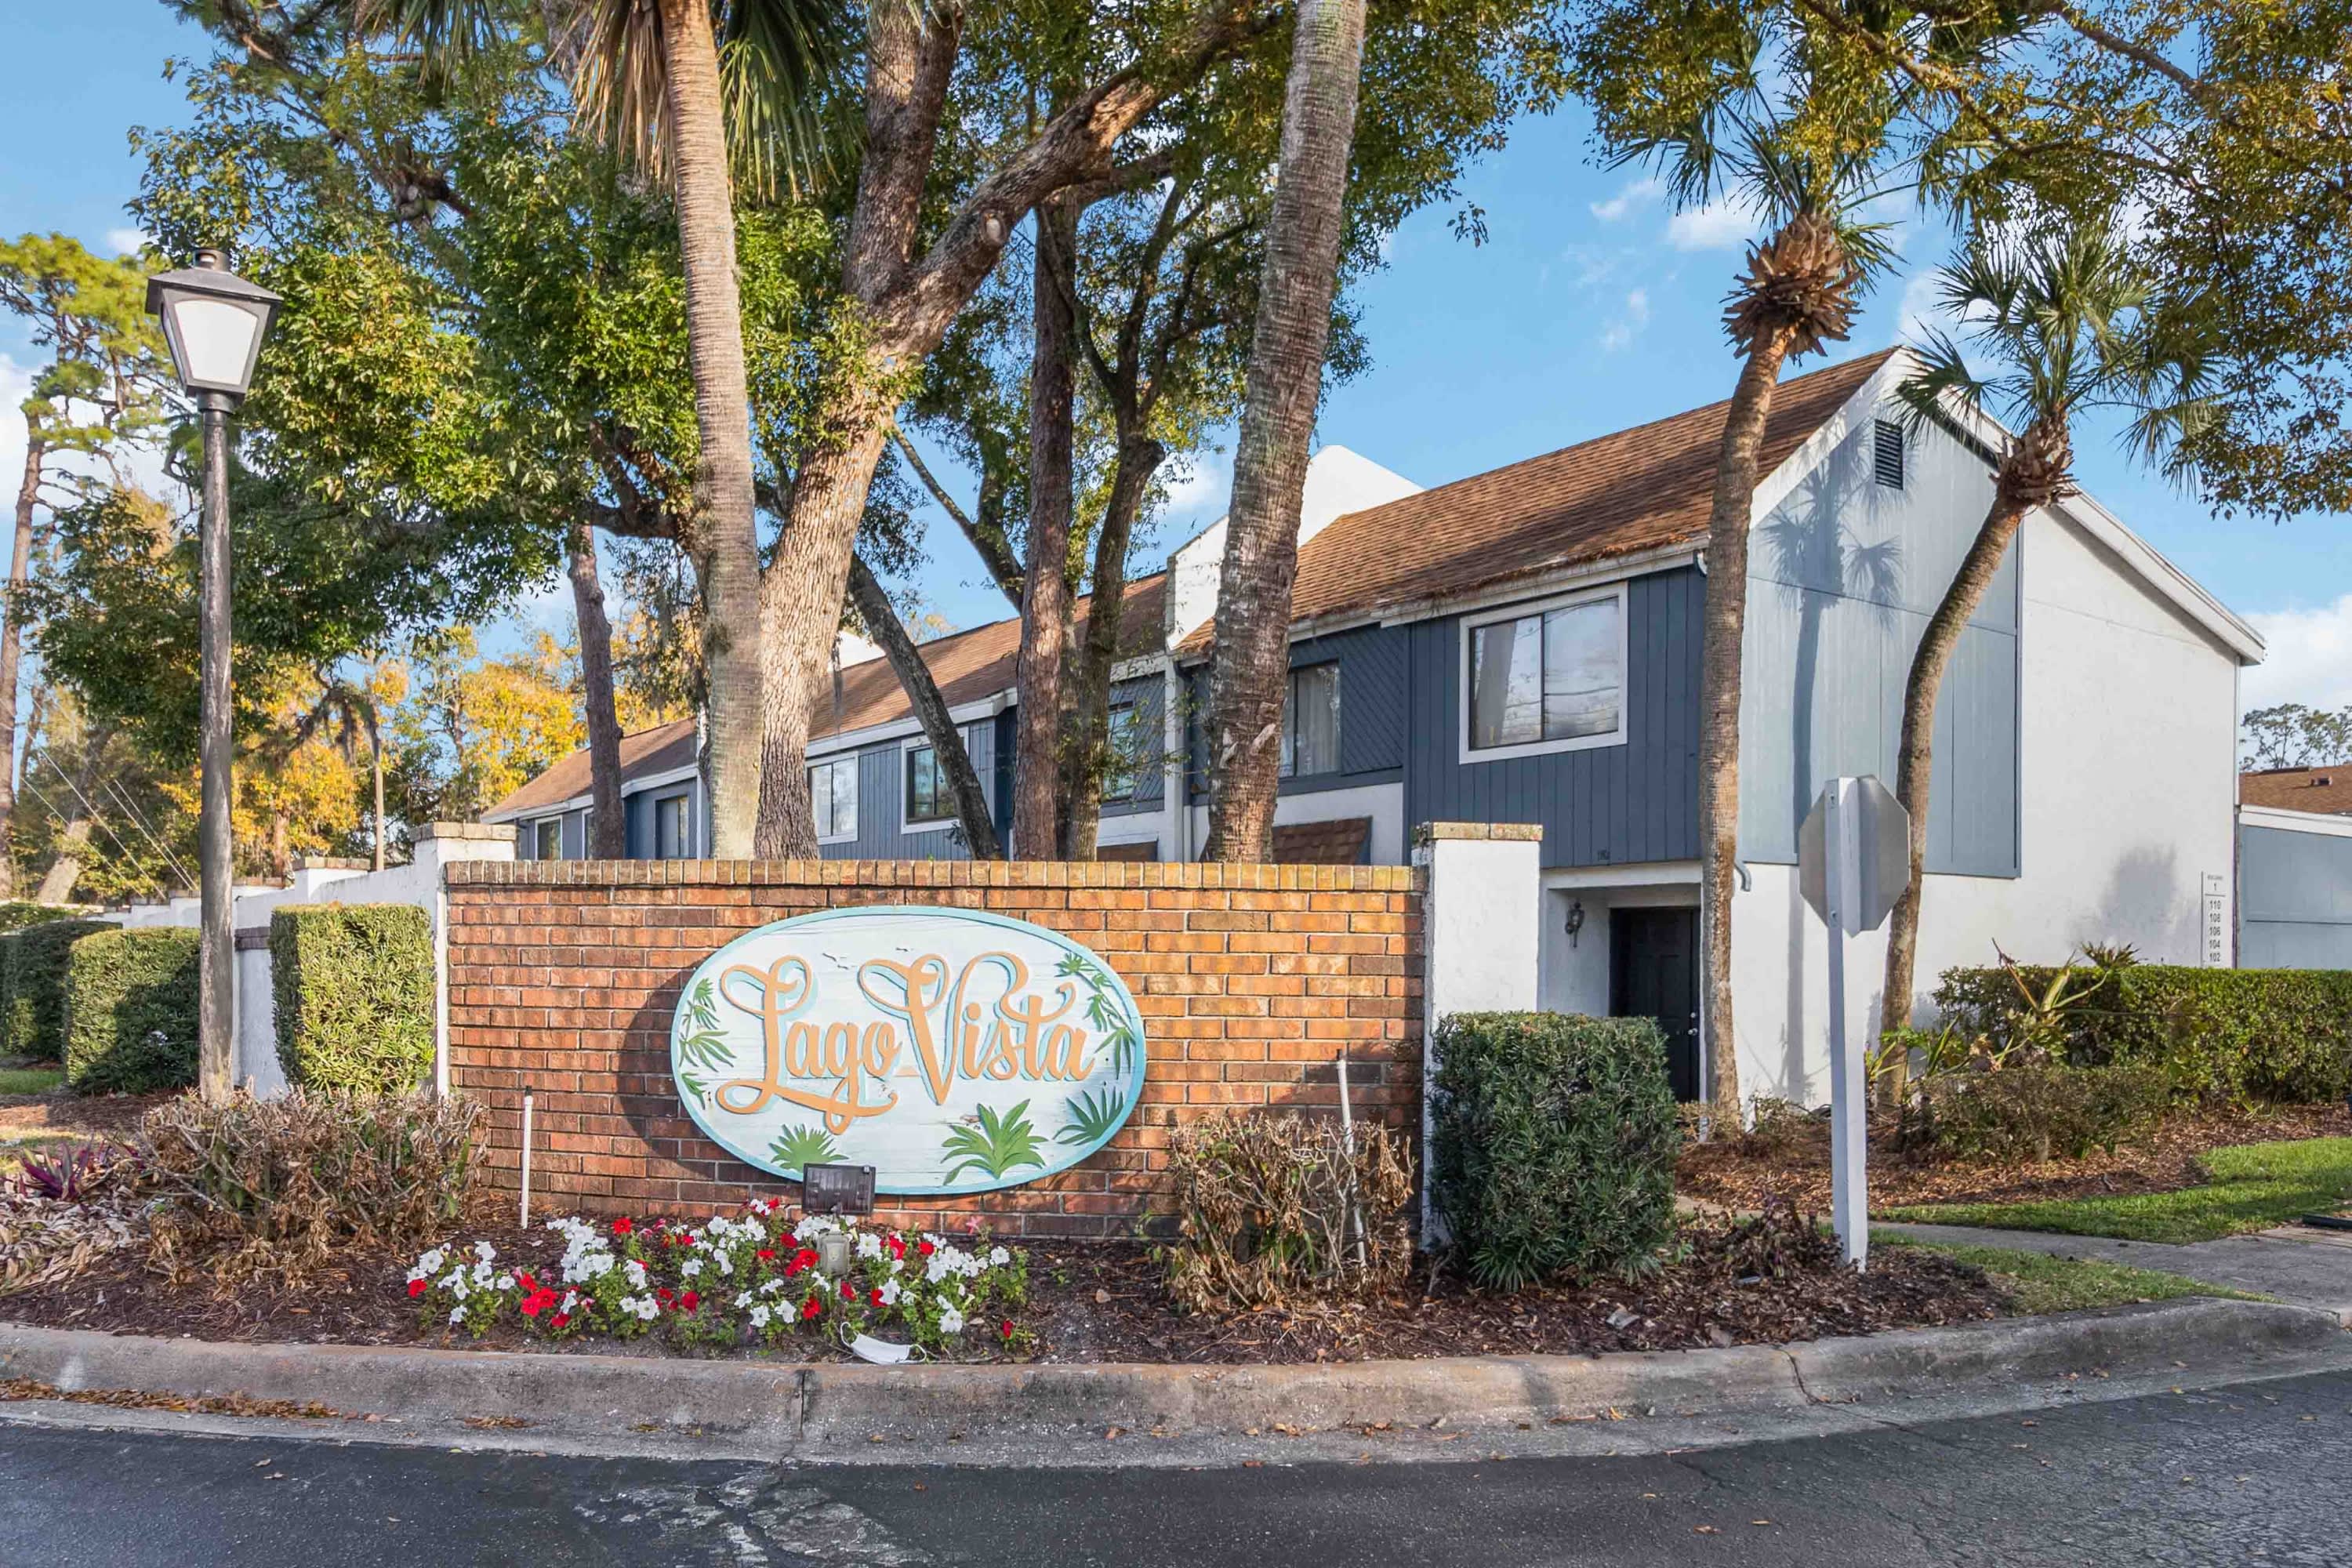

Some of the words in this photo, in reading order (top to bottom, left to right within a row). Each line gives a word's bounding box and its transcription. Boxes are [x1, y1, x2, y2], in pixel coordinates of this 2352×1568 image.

[2209, 939, 2221, 949] 104
[2209, 952, 2221, 963] 102
[717, 954, 902, 1135] Lago
[859, 951, 1095, 1105] Vista
